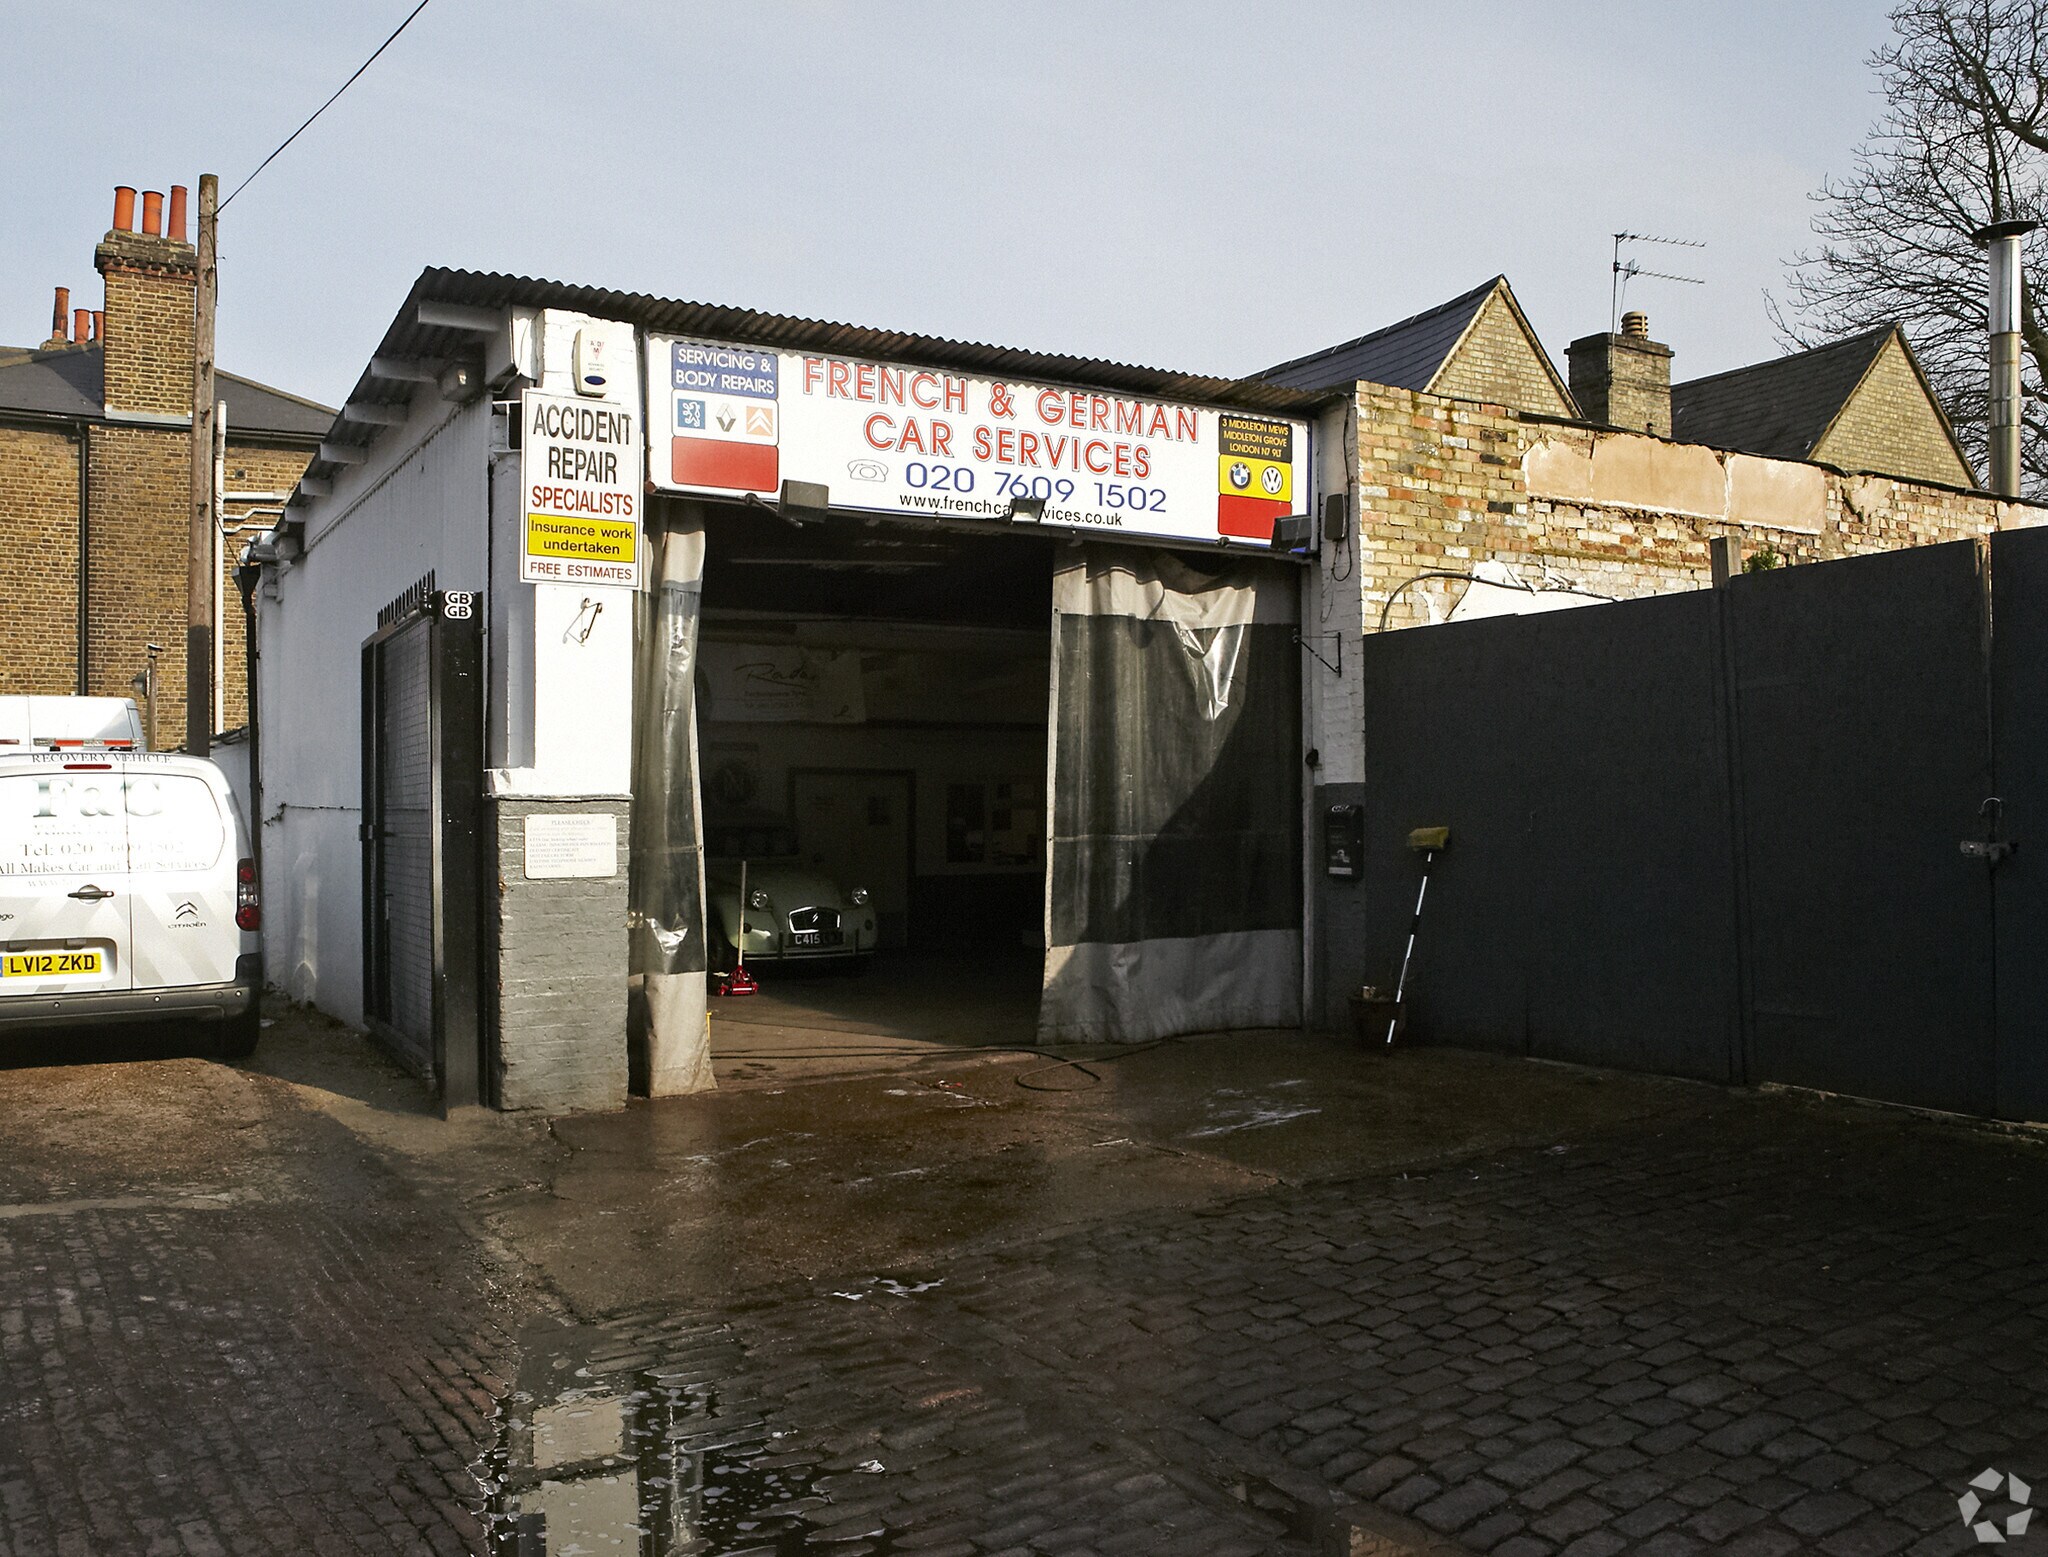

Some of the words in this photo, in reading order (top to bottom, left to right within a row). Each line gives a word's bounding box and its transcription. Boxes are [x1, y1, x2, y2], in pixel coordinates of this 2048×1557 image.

[678, 348, 756, 371] SERVICING
[760, 357, 772, 373] &
[675, 369, 717, 387] BODY
[721, 374, 775, 394] REPAIRS
[803, 356, 968, 414] FRENCH
[988, 382, 1017, 420] &
[1036, 388, 1199, 443] GERMAN
[533, 403, 632, 445] ACCIDENT
[1222, 418, 1228, 427] 3
[1229, 419, 1267, 433] MIDDLETON
[1268, 425, 1289, 436] MEWS
[863, 411, 954, 458] CAR
[973, 424, 1151, 480] SERVICES
[1223, 430, 1262, 443] MIDDLETON
[1263, 435, 1287, 447] GROVE
[1229, 442, 1260, 454] LONDON
[1261, 447, 1270, 455] N7
[548, 446, 618, 484] REPAIR
[905, 462, 975, 493] 020
[994, 471, 1075, 503] 7609
[1094, 482, 1167, 513] 1502
[532, 485, 633, 516] SPECIALISTS
[899, 494, 1123, 526] www.frenchcavices.co.uk
[531, 520, 595, 536] Insurance
[601, 528, 632, 539] work
[543, 540, 620, 554] undertaken
[531, 562, 561, 575] FREE
[567, 564, 632, 580] ESTIMATES
[448, 592, 470, 604] GB
[447, 605, 469, 617] GB
[32, 754, 107, 763] RECOVERY
[113, 753, 172, 763] VEHICLE
[21, 861, 64, 874] Makes
[794, 933, 820, 945] C415
[10, 956, 53, 974] LV12
[59, 954, 95, 971] ZKD
